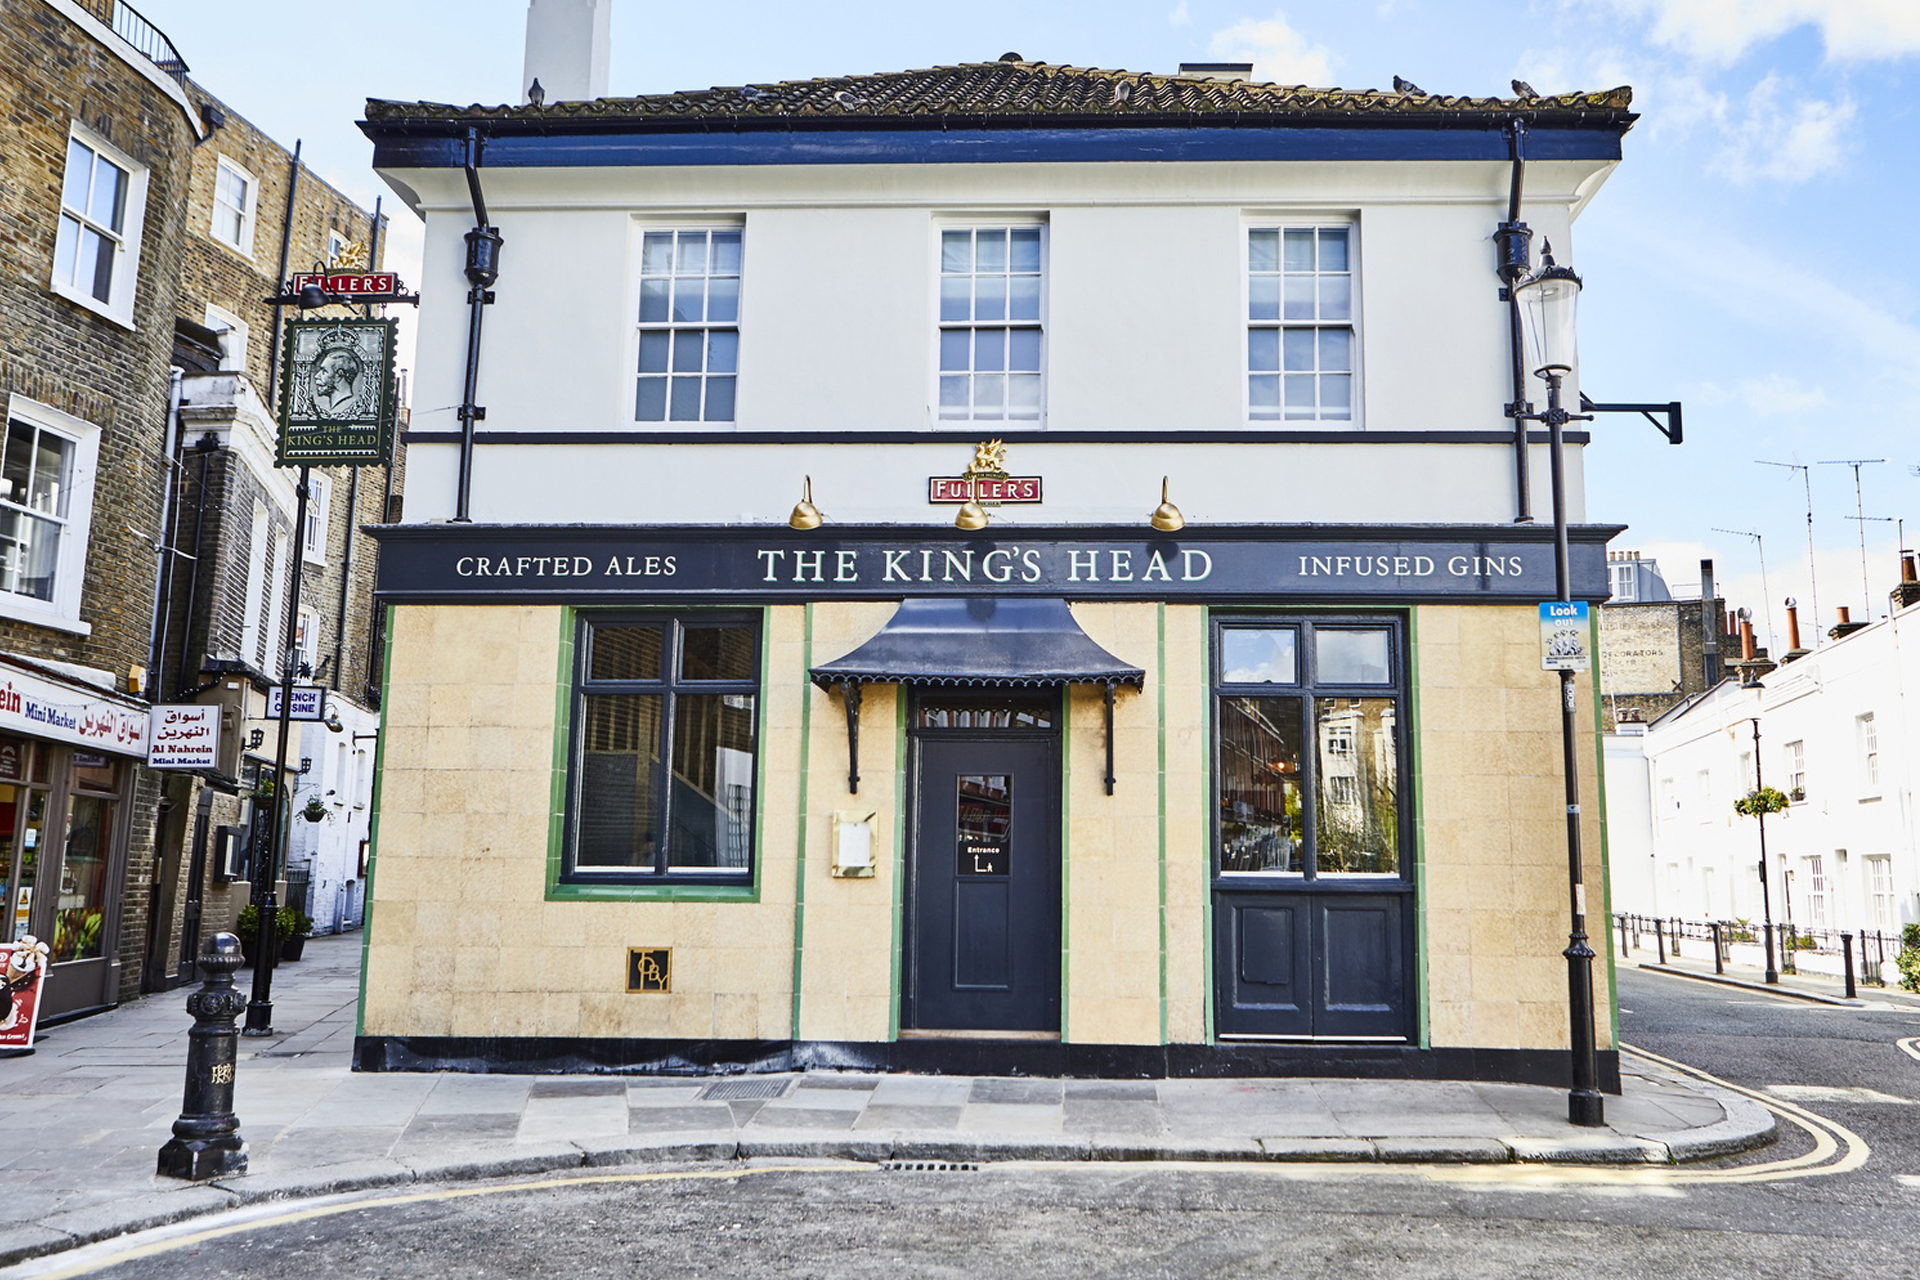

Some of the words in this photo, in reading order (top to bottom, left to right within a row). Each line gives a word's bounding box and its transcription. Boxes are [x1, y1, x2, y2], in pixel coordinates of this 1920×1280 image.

[322, 425, 342, 434] THE
[287, 434, 334, 446] KING'S
[338, 434, 376, 445] HEAD
[456, 556, 593, 577] CRAFTED
[604, 556, 678, 576] ALES
[757, 549, 858, 582] THE
[882, 546, 1042, 582] KING'S
[1067, 550, 1214, 582] HEAD
[1298, 556, 1435, 577] INFUSED
[1448, 556, 1523, 577] GINS
[1550, 604, 1578, 616] Look
[275, 692, 316, 702] FENCH
[274, 703, 315, 713] CSINE
[25, 701, 47, 722] Mini
[47, 708, 76, 730] Market
[165, 708, 205, 724] أسواق
[157, 726, 210, 740] النهرين
[152, 744, 164, 753] Al
[168, 744, 213, 753] Nahrein
[967, 846, 1000, 854] Entrance
